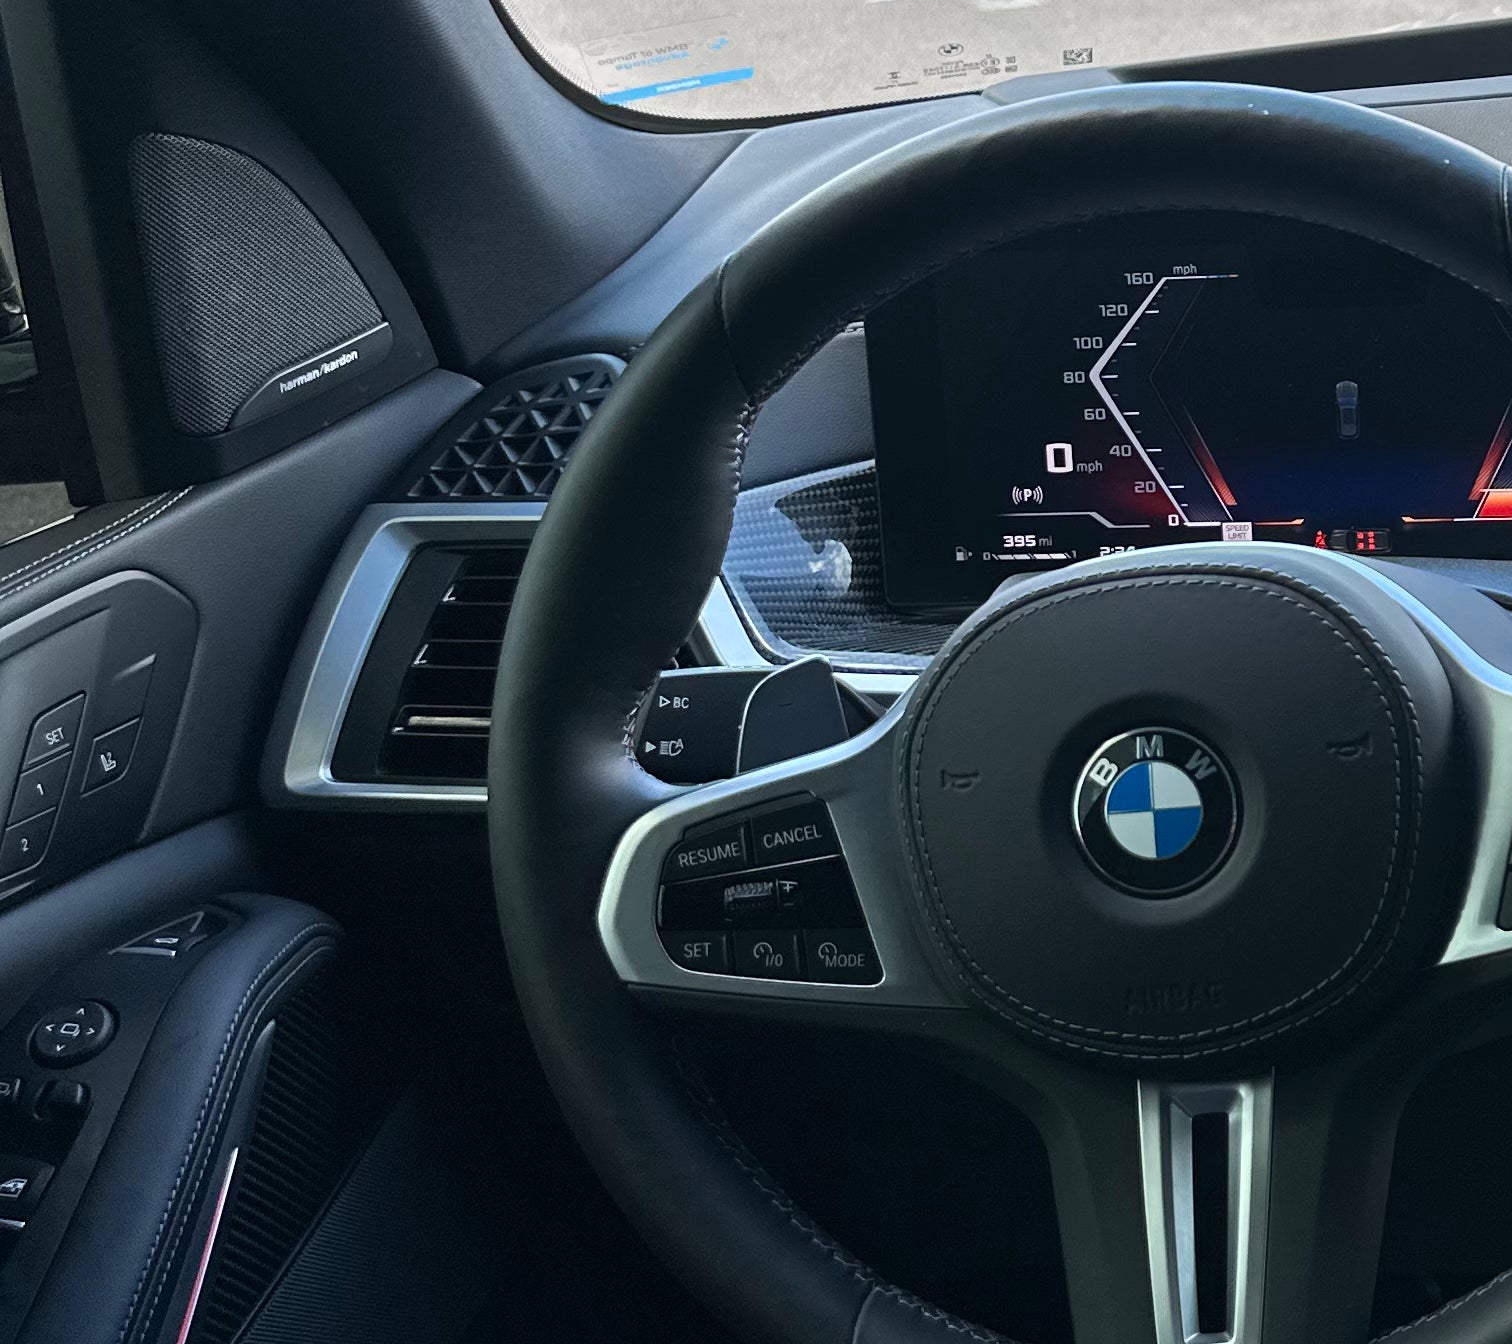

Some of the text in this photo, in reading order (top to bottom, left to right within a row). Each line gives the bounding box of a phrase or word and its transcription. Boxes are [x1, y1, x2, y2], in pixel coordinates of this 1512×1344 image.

[1173, 264, 1197, 275] mph
[1124, 272, 1154, 285] 160
[1098, 304, 1128, 317] 120
[1073, 337, 1103, 350] 100
[279, 349, 359, 394] harman/kardon
[1063, 371, 1086, 384] 80
[1084, 408, 1106, 421] 60
[1109, 445, 1132, 457] 40
[1046, 443, 1073, 473] 0
[1076, 460, 1103, 474] mph
[1134, 481, 1156, 493] 20
[1168, 514, 1179, 526] 0
[1225, 524, 1249, 532] SPEED
[1003, 535, 1036, 547] 395
[673, 696, 690, 709] BC
[45, 727, 66, 746] SET
[1089, 734, 1218, 788] BMW
[36, 783, 45, 796] 1
[763, 824, 823, 849] CANCEL
[20, 838, 30, 852] 2
[678, 841, 742, 869] RESUME
[684, 942, 712, 958] SET
[825, 954, 866, 968] MODE
